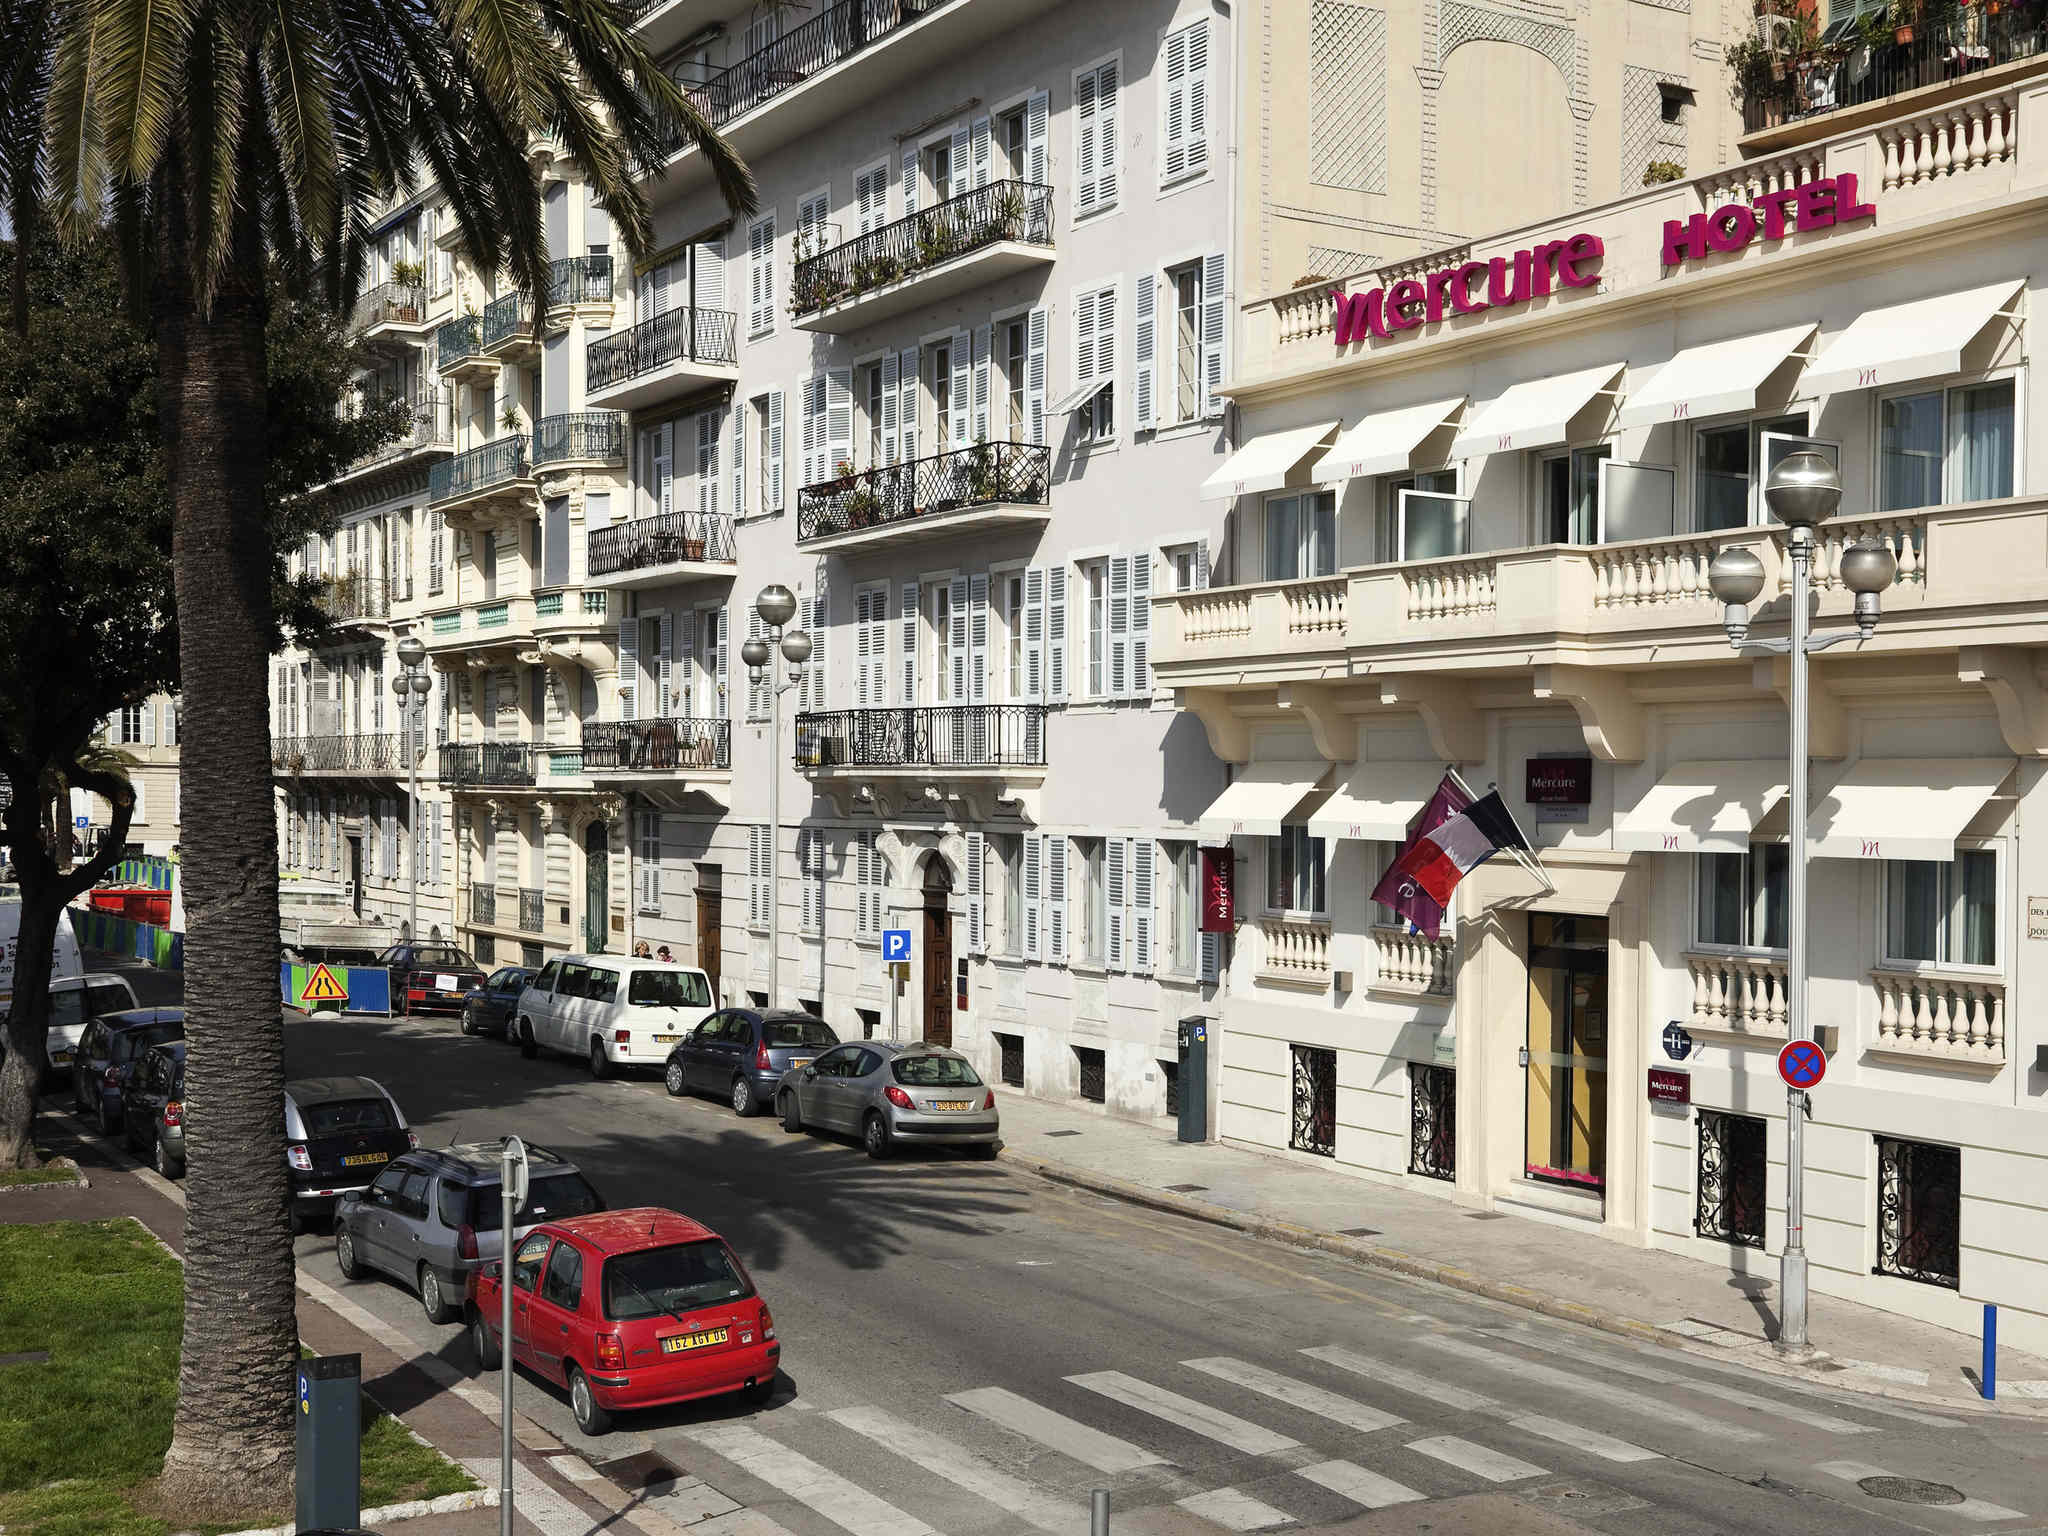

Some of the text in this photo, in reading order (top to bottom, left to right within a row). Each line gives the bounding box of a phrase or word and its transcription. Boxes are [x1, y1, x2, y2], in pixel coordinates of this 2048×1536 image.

[1662, 172, 1877, 266] HOTEL
[1531, 776, 1576, 788] Mercure
[1218, 861, 1228, 919] Mercure
[890, 935, 904, 956] P
[1196, 1027, 1203, 1037] P
[1671, 1033, 1681, 1048] H
[1651, 1081, 1683, 1093] Mercure
[669, 1337, 688, 1350] 162
[692, 1331, 710, 1347] AGV
[714, 1328, 727, 1342] 06
[301, 1377, 308, 1400] P
